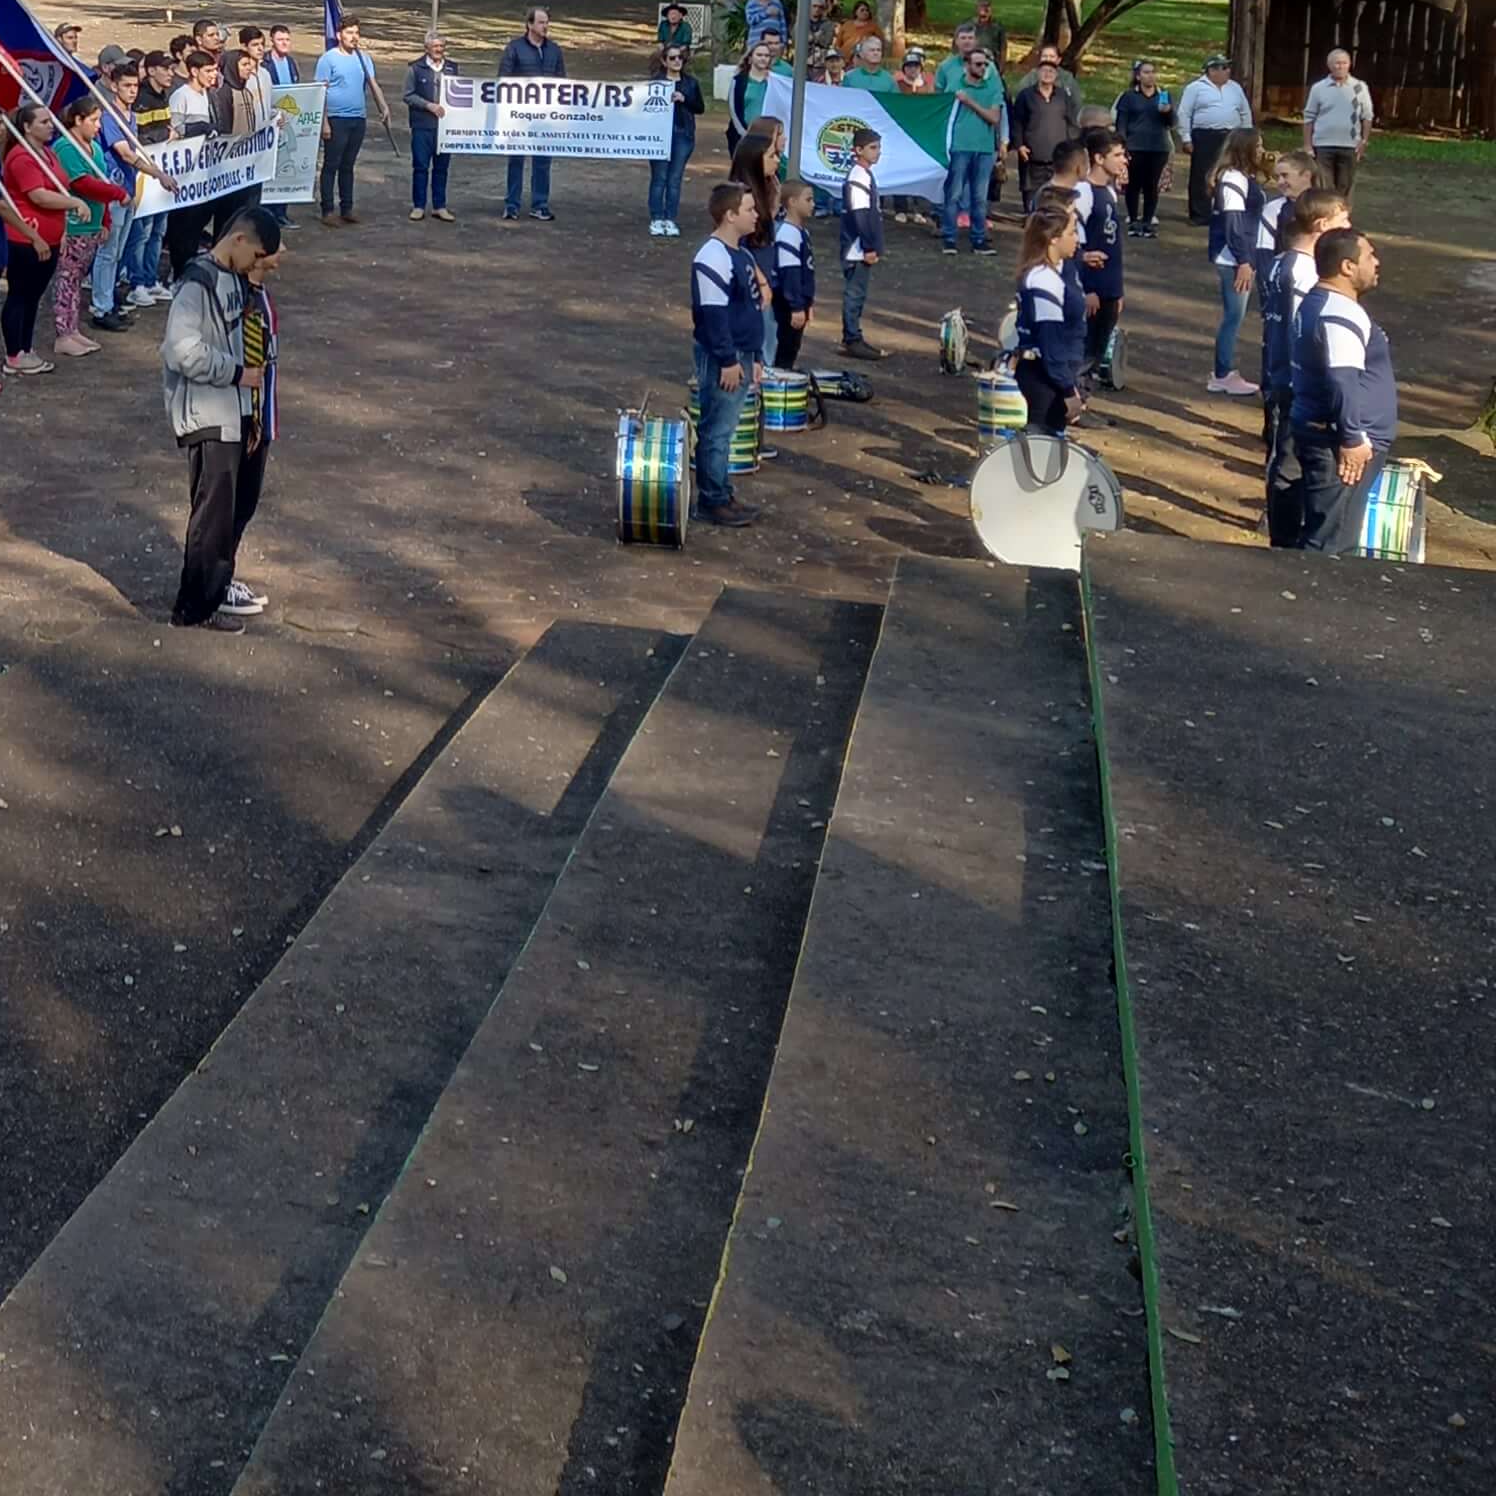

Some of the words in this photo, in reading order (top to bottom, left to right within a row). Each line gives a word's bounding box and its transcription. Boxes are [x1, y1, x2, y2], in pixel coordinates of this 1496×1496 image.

[480, 81, 634, 108] EMATER/RS
[510, 110, 546, 121] Roque
[550, 111, 604, 122] Gonzales
